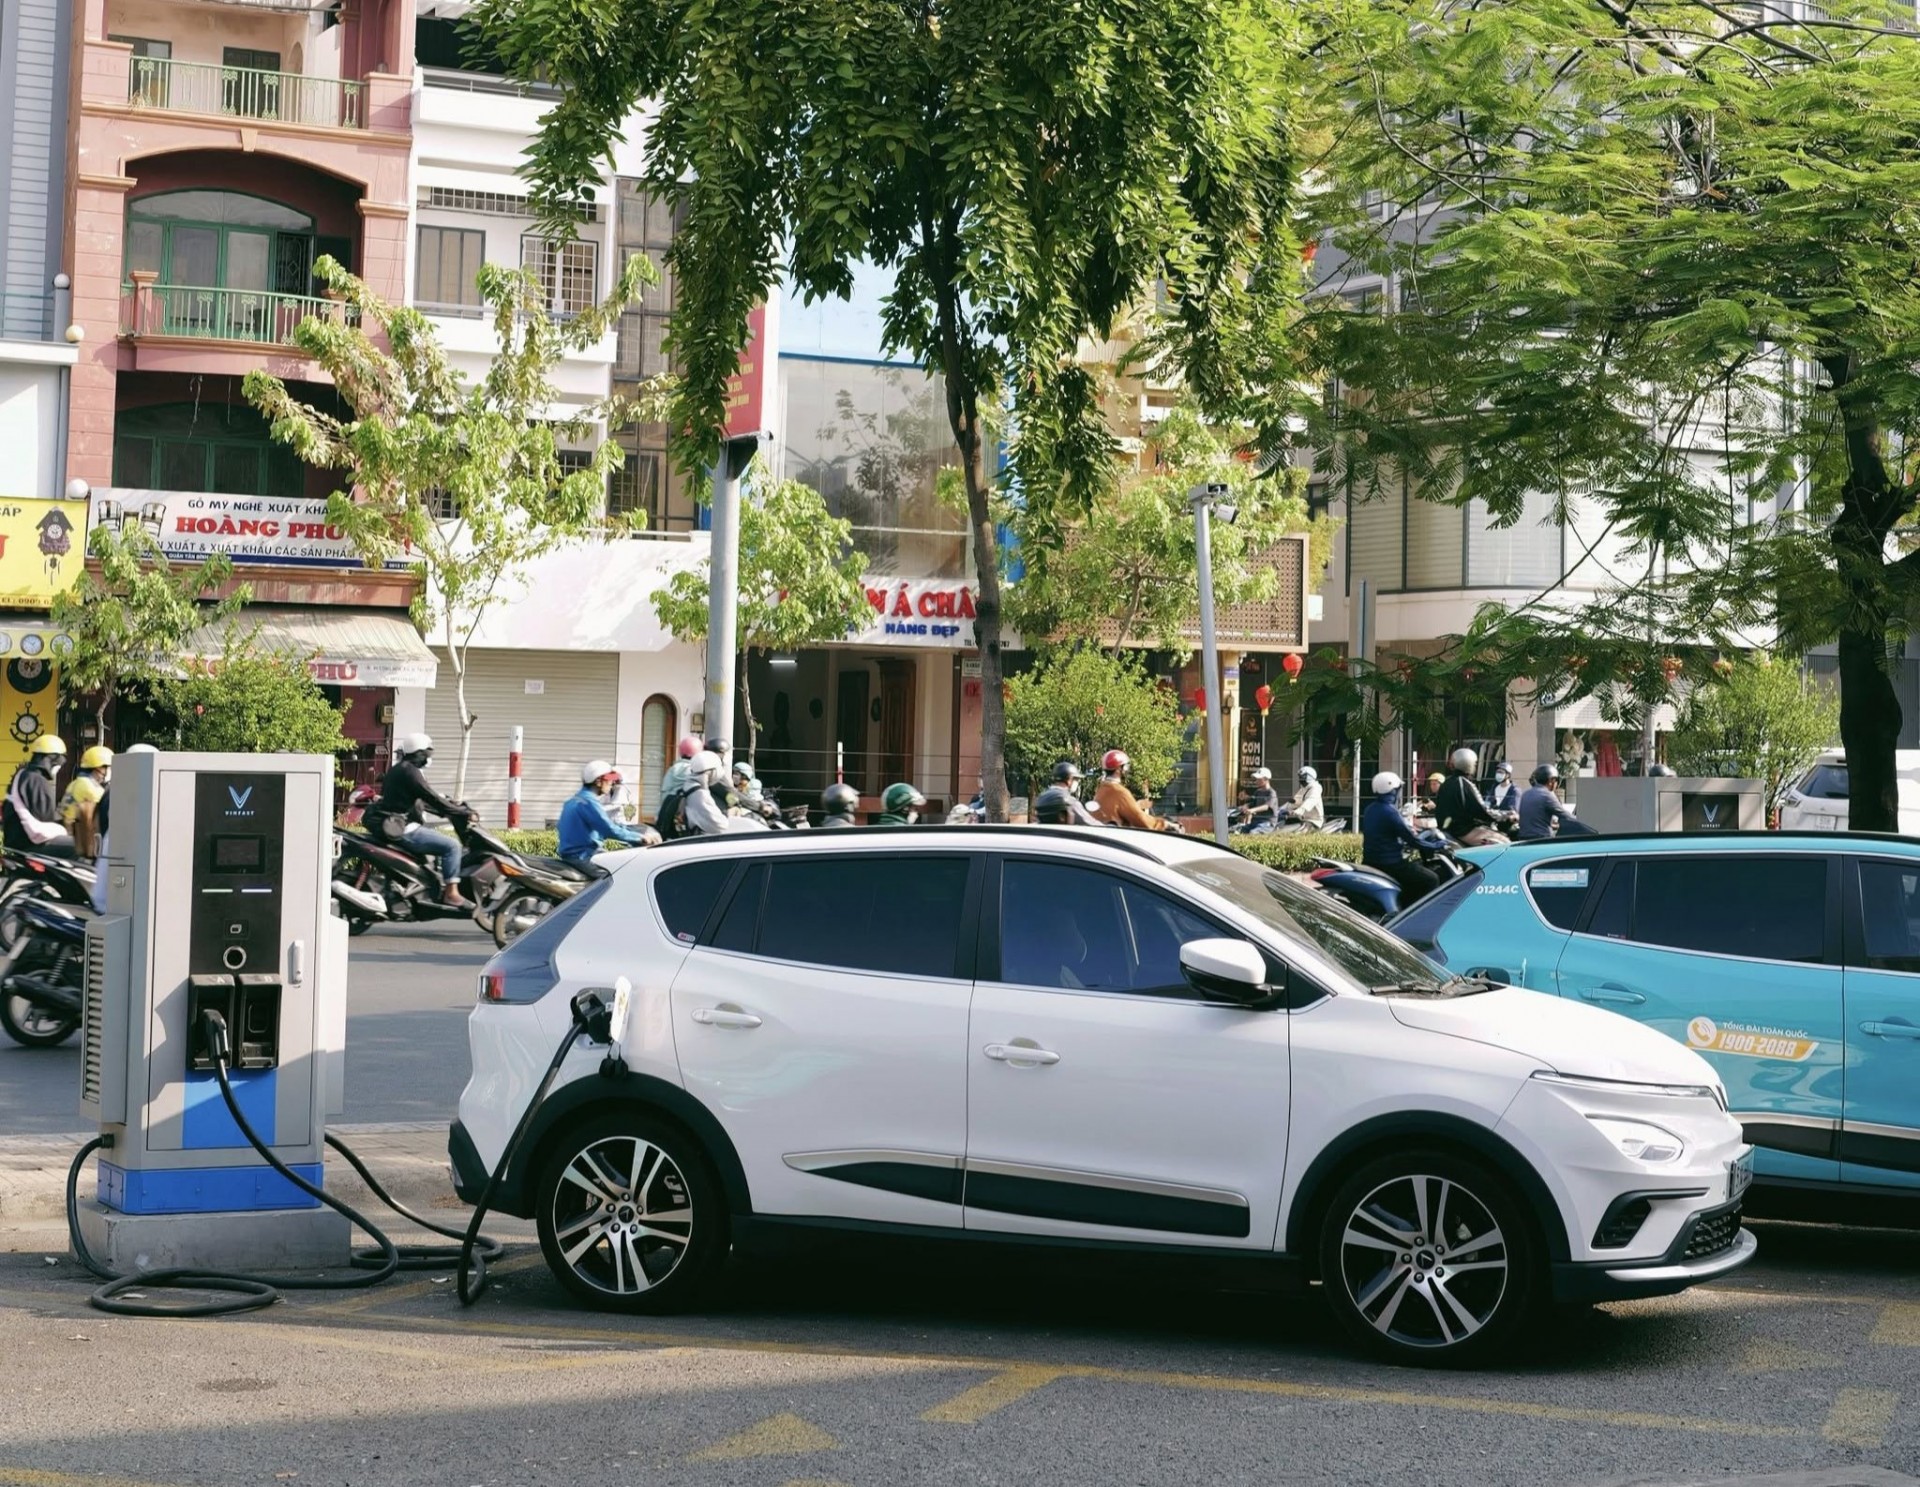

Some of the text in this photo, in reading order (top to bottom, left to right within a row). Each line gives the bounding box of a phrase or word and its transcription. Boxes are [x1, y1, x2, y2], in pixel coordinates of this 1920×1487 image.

[0, 502, 22, 517] ẤP
[175, 514, 280, 538] HOÀNG
[199, 542, 206, 551] &
[275, 544, 297, 556] CÁC
[891, 583, 913, 617] Á
[917, 586, 979, 619] CHÂ
[931, 625, 960, 638] ĐẸP
[1475, 885, 1519, 895] 01244C
[1762, 1026, 1784, 1037] TOÀN
[1718, 1032, 1798, 1057] 1900-2088
